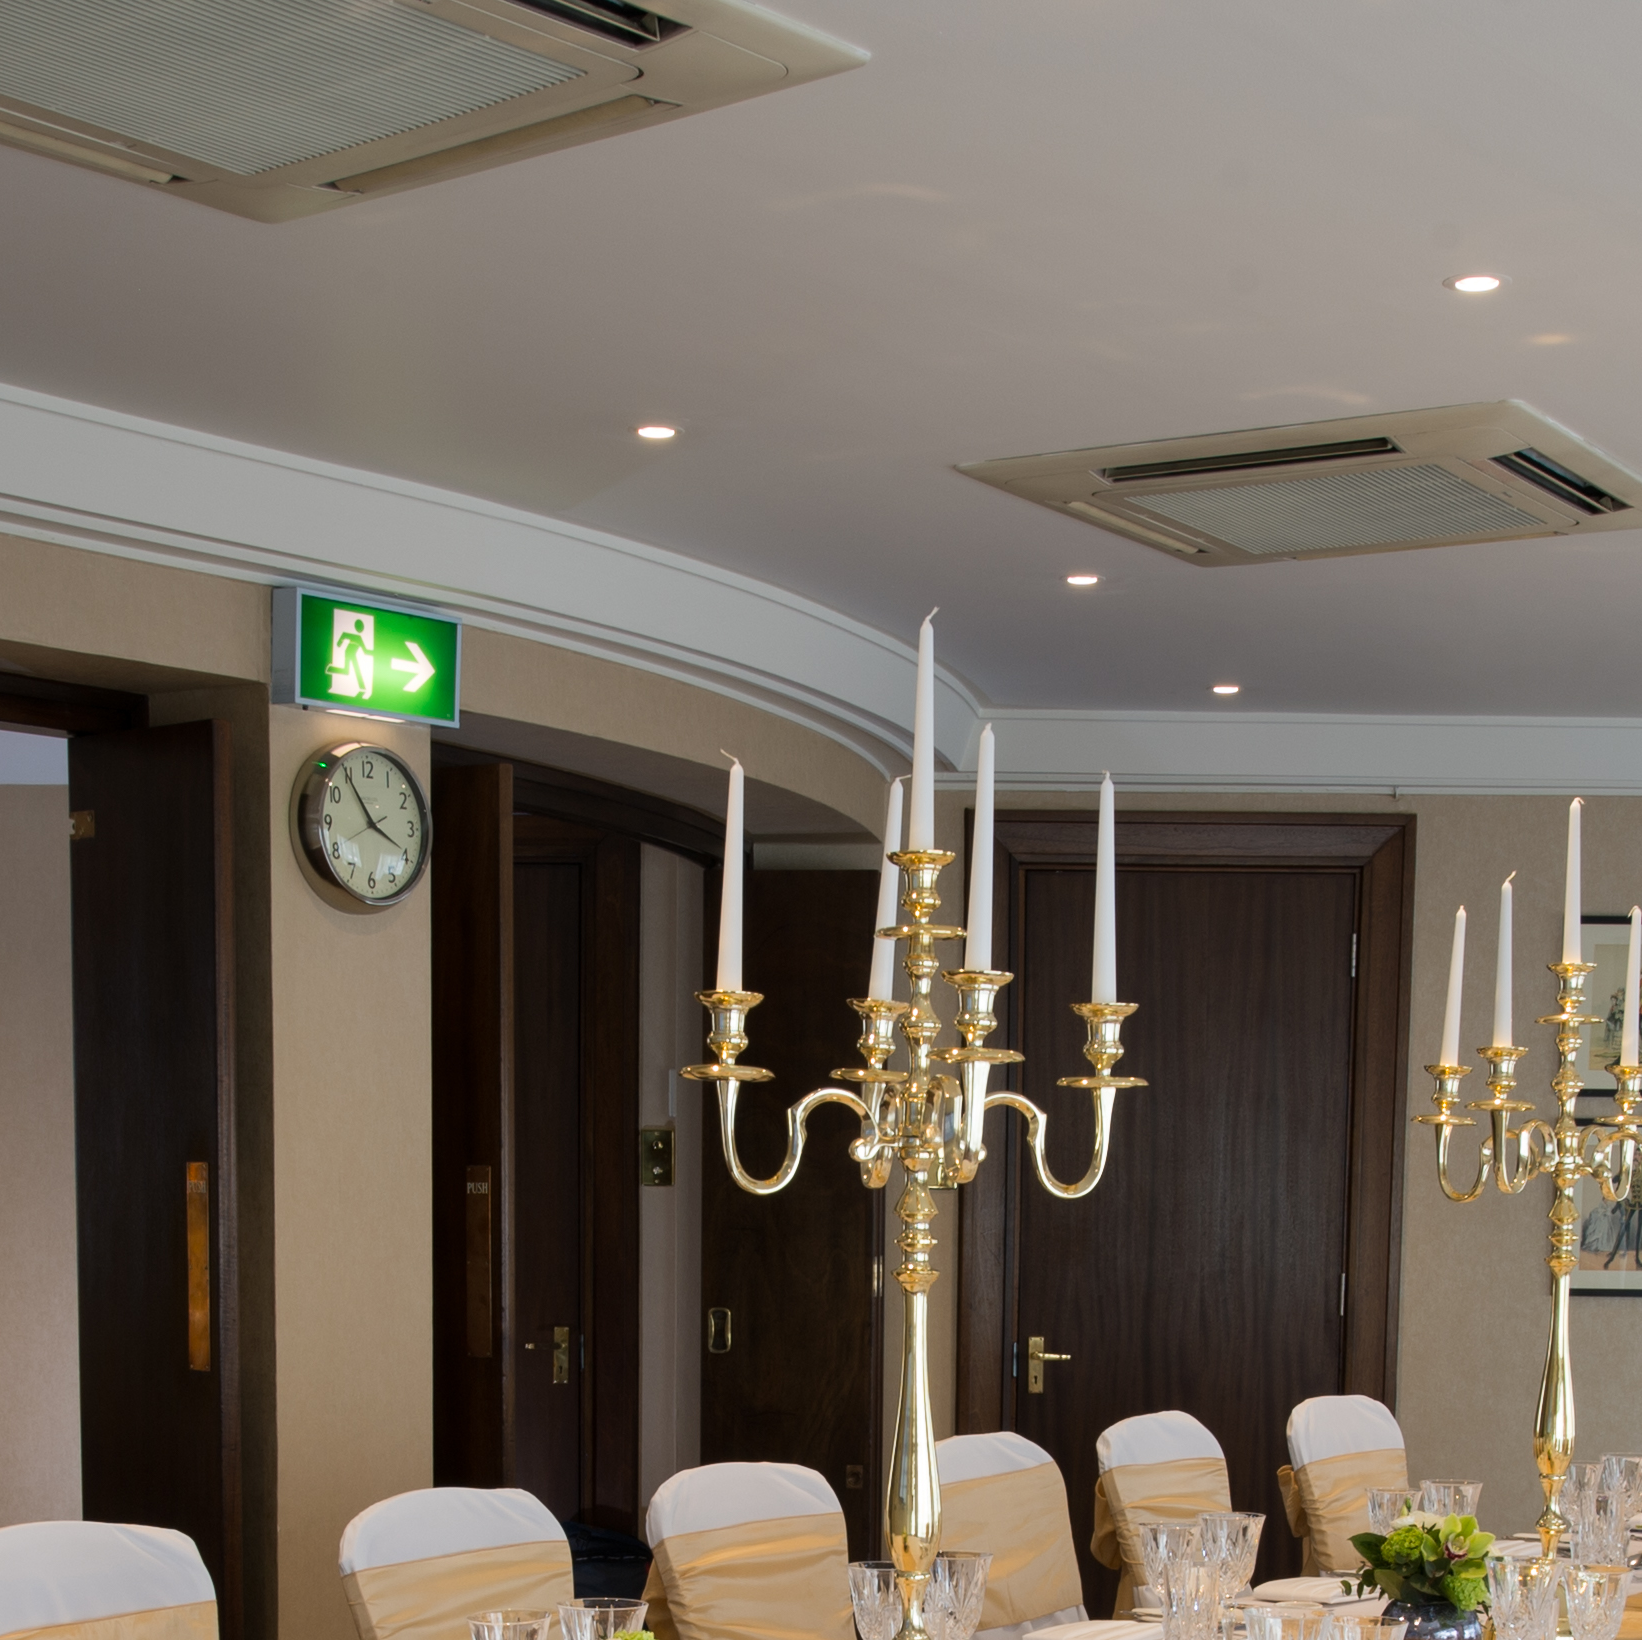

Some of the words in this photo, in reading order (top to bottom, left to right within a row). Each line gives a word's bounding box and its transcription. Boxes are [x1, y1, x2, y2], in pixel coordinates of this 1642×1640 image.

[361, 760, 374, 779] 12
[385, 770, 390, 788] 1
[329, 785, 341, 804] 10
[399, 792, 408, 810] 2
[324, 814, 333, 831] 9
[407, 820, 415, 838] 3
[332, 842, 340, 860] 8
[401, 848, 409, 864] 4
[347, 862, 356, 879] 7
[388, 865, 396, 883] 5
[367, 871, 376, 889] 6
[466, 1182, 488, 1194] PUSH
